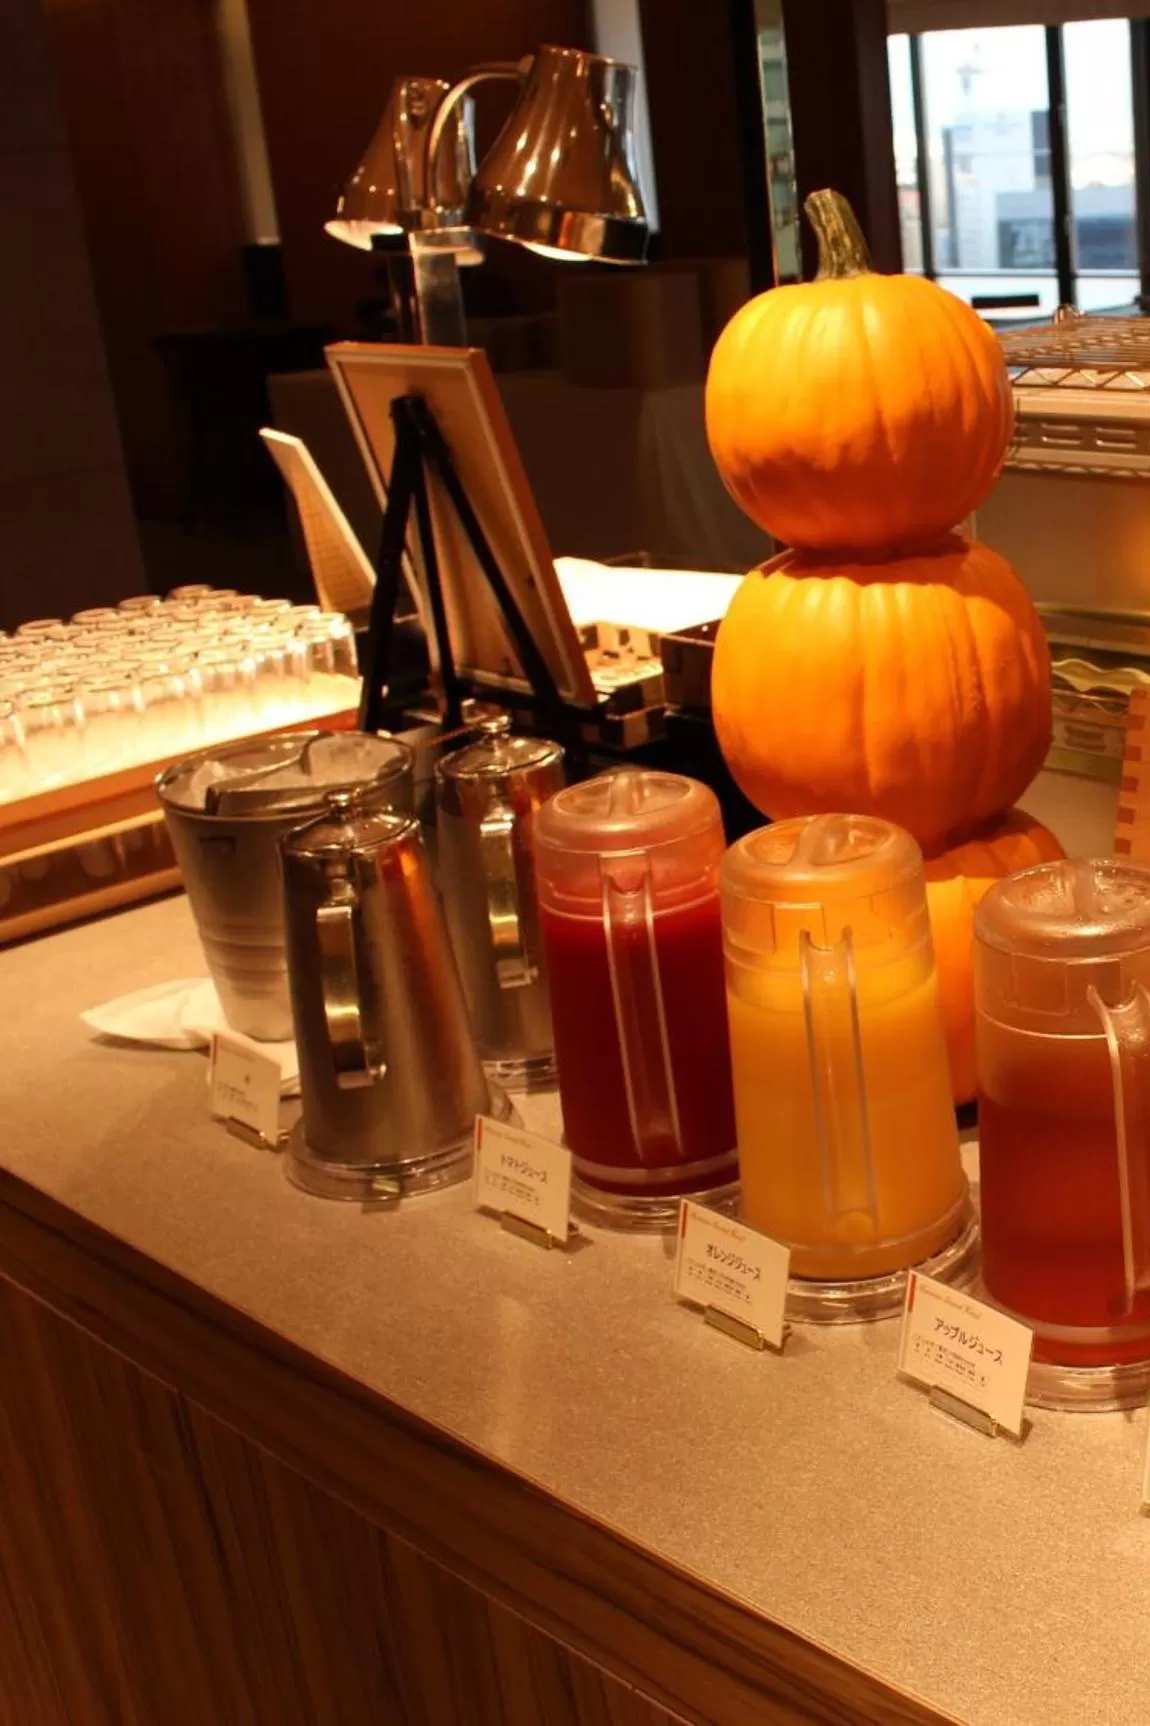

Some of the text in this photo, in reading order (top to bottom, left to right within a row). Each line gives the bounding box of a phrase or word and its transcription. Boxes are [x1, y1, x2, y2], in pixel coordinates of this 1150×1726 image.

[933, 1316, 1004, 1367] アップルジュース
